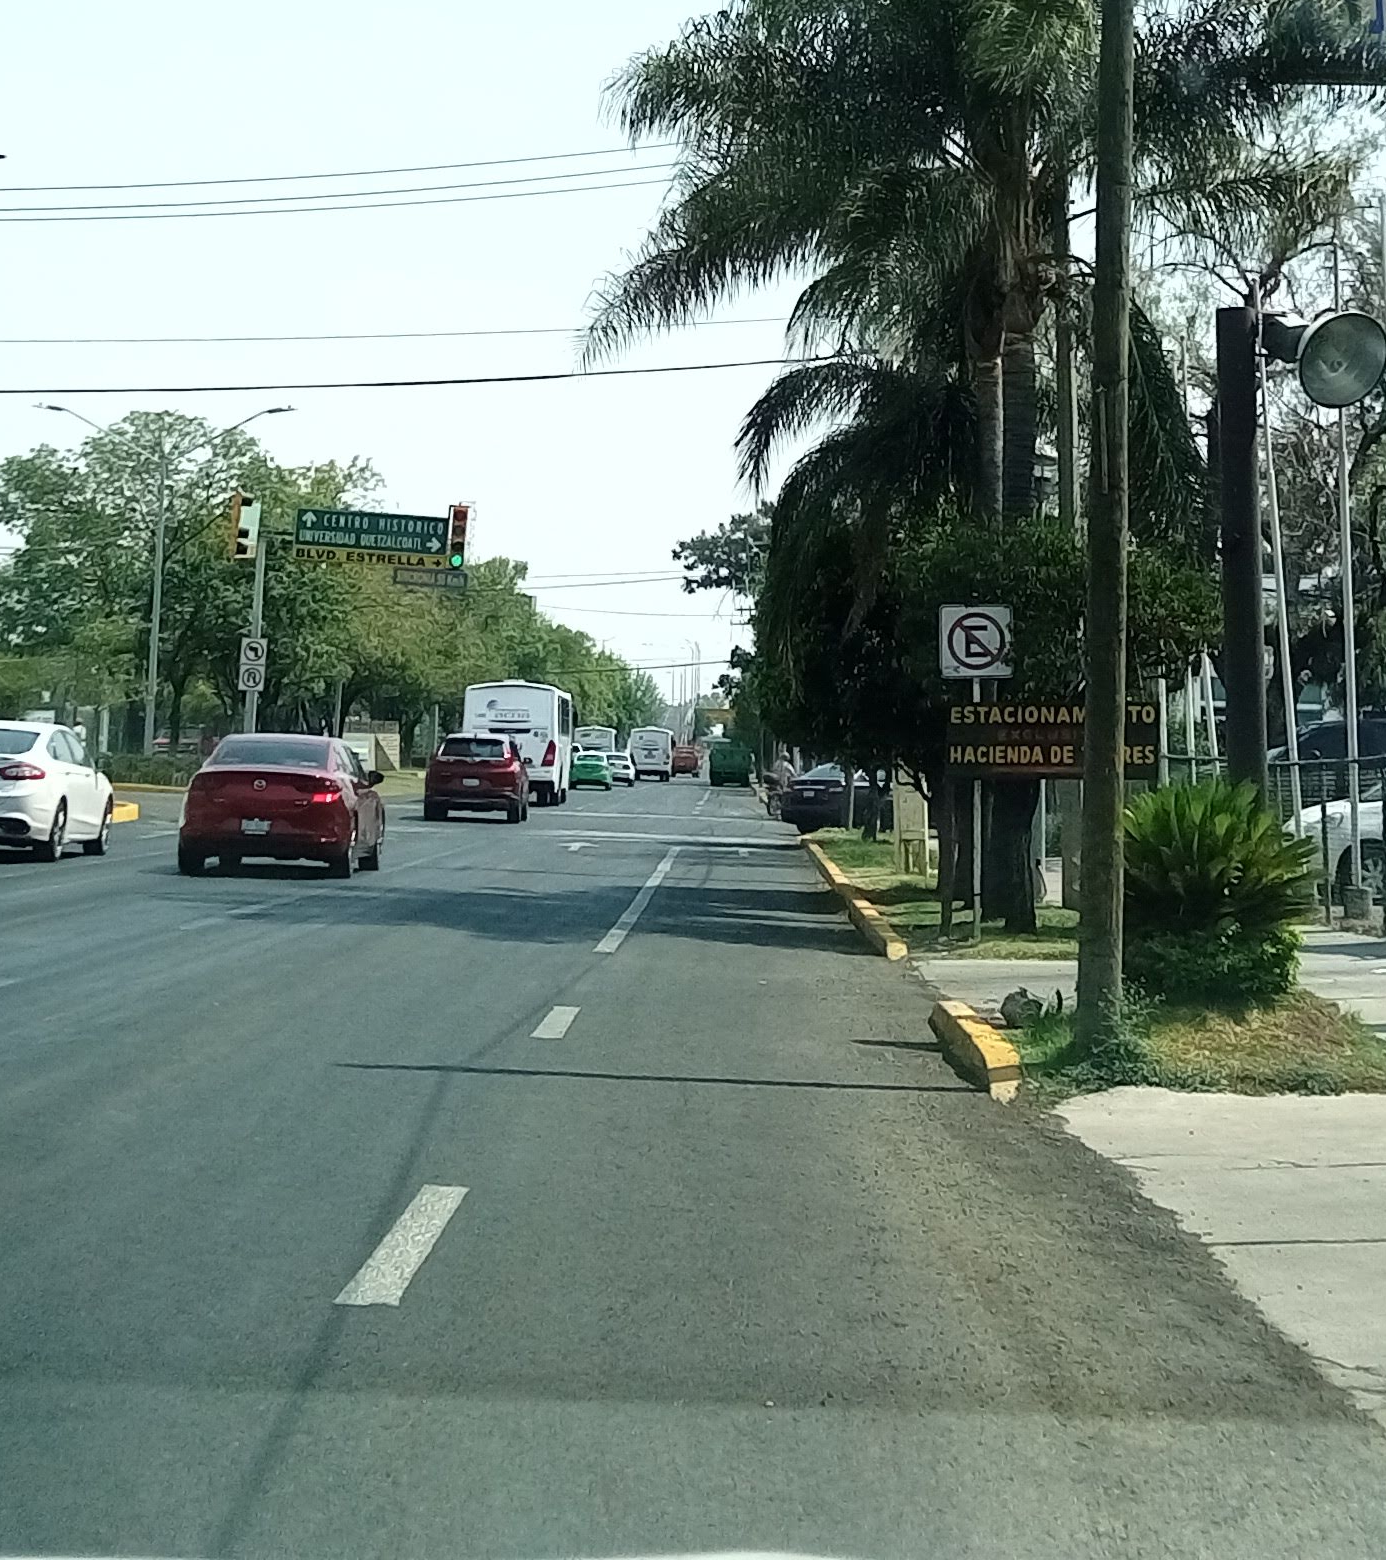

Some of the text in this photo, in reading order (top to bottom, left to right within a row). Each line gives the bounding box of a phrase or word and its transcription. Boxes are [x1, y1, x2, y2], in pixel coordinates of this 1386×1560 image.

[323, 513, 444, 535] CENTRO HISTORICO
[298, 528, 423, 550] UNIVERSIDAD QUETZALCOATL
[295, 547, 426, 567] BLVD. ESTRELLA
[949, 745, 1044, 764] HACIENDA
[1050, 746, 1074, 764] DE
